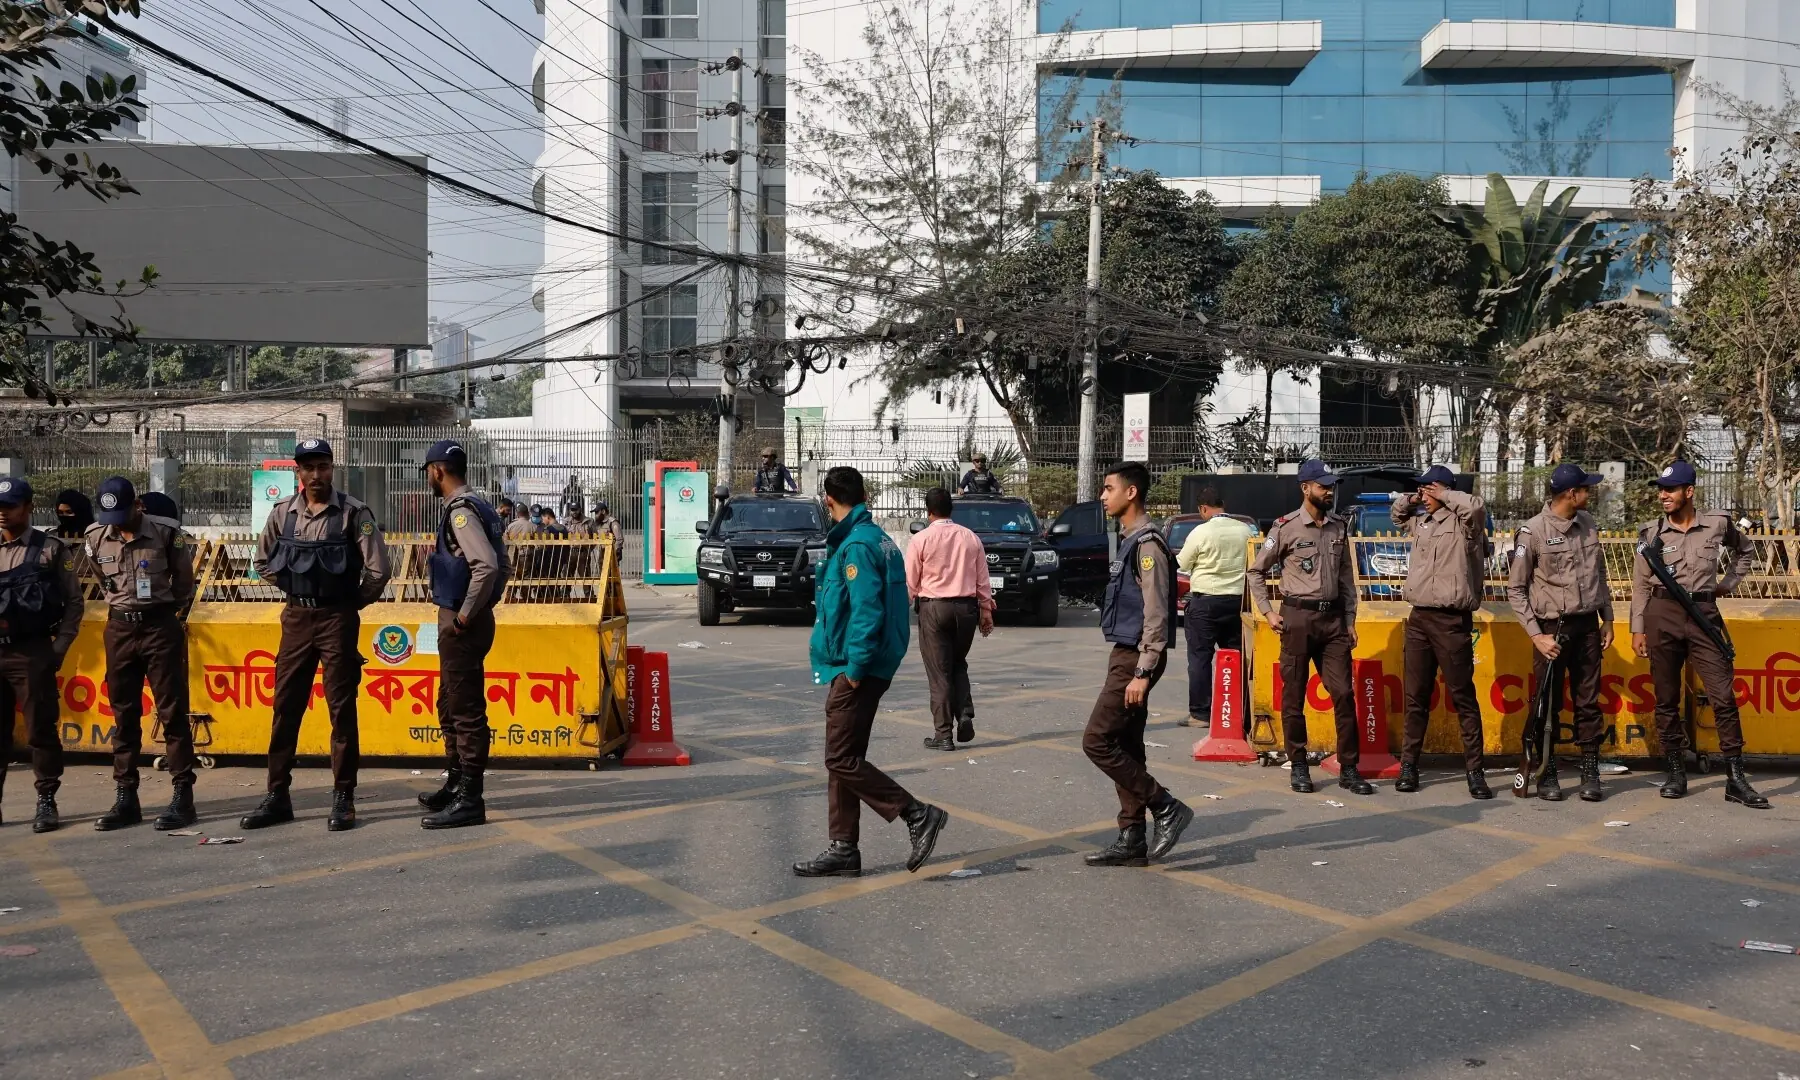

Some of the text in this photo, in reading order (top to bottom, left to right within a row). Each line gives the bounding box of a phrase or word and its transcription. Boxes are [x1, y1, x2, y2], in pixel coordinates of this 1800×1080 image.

[526, 666, 581, 717] না
[627, 664, 636, 723] GAZI TANKS
[651, 670, 661, 731] GAZI TANKS
[1221, 667, 1232, 728] GAZI TANKS
[1364, 678, 1377, 742] GAZI TANKS
